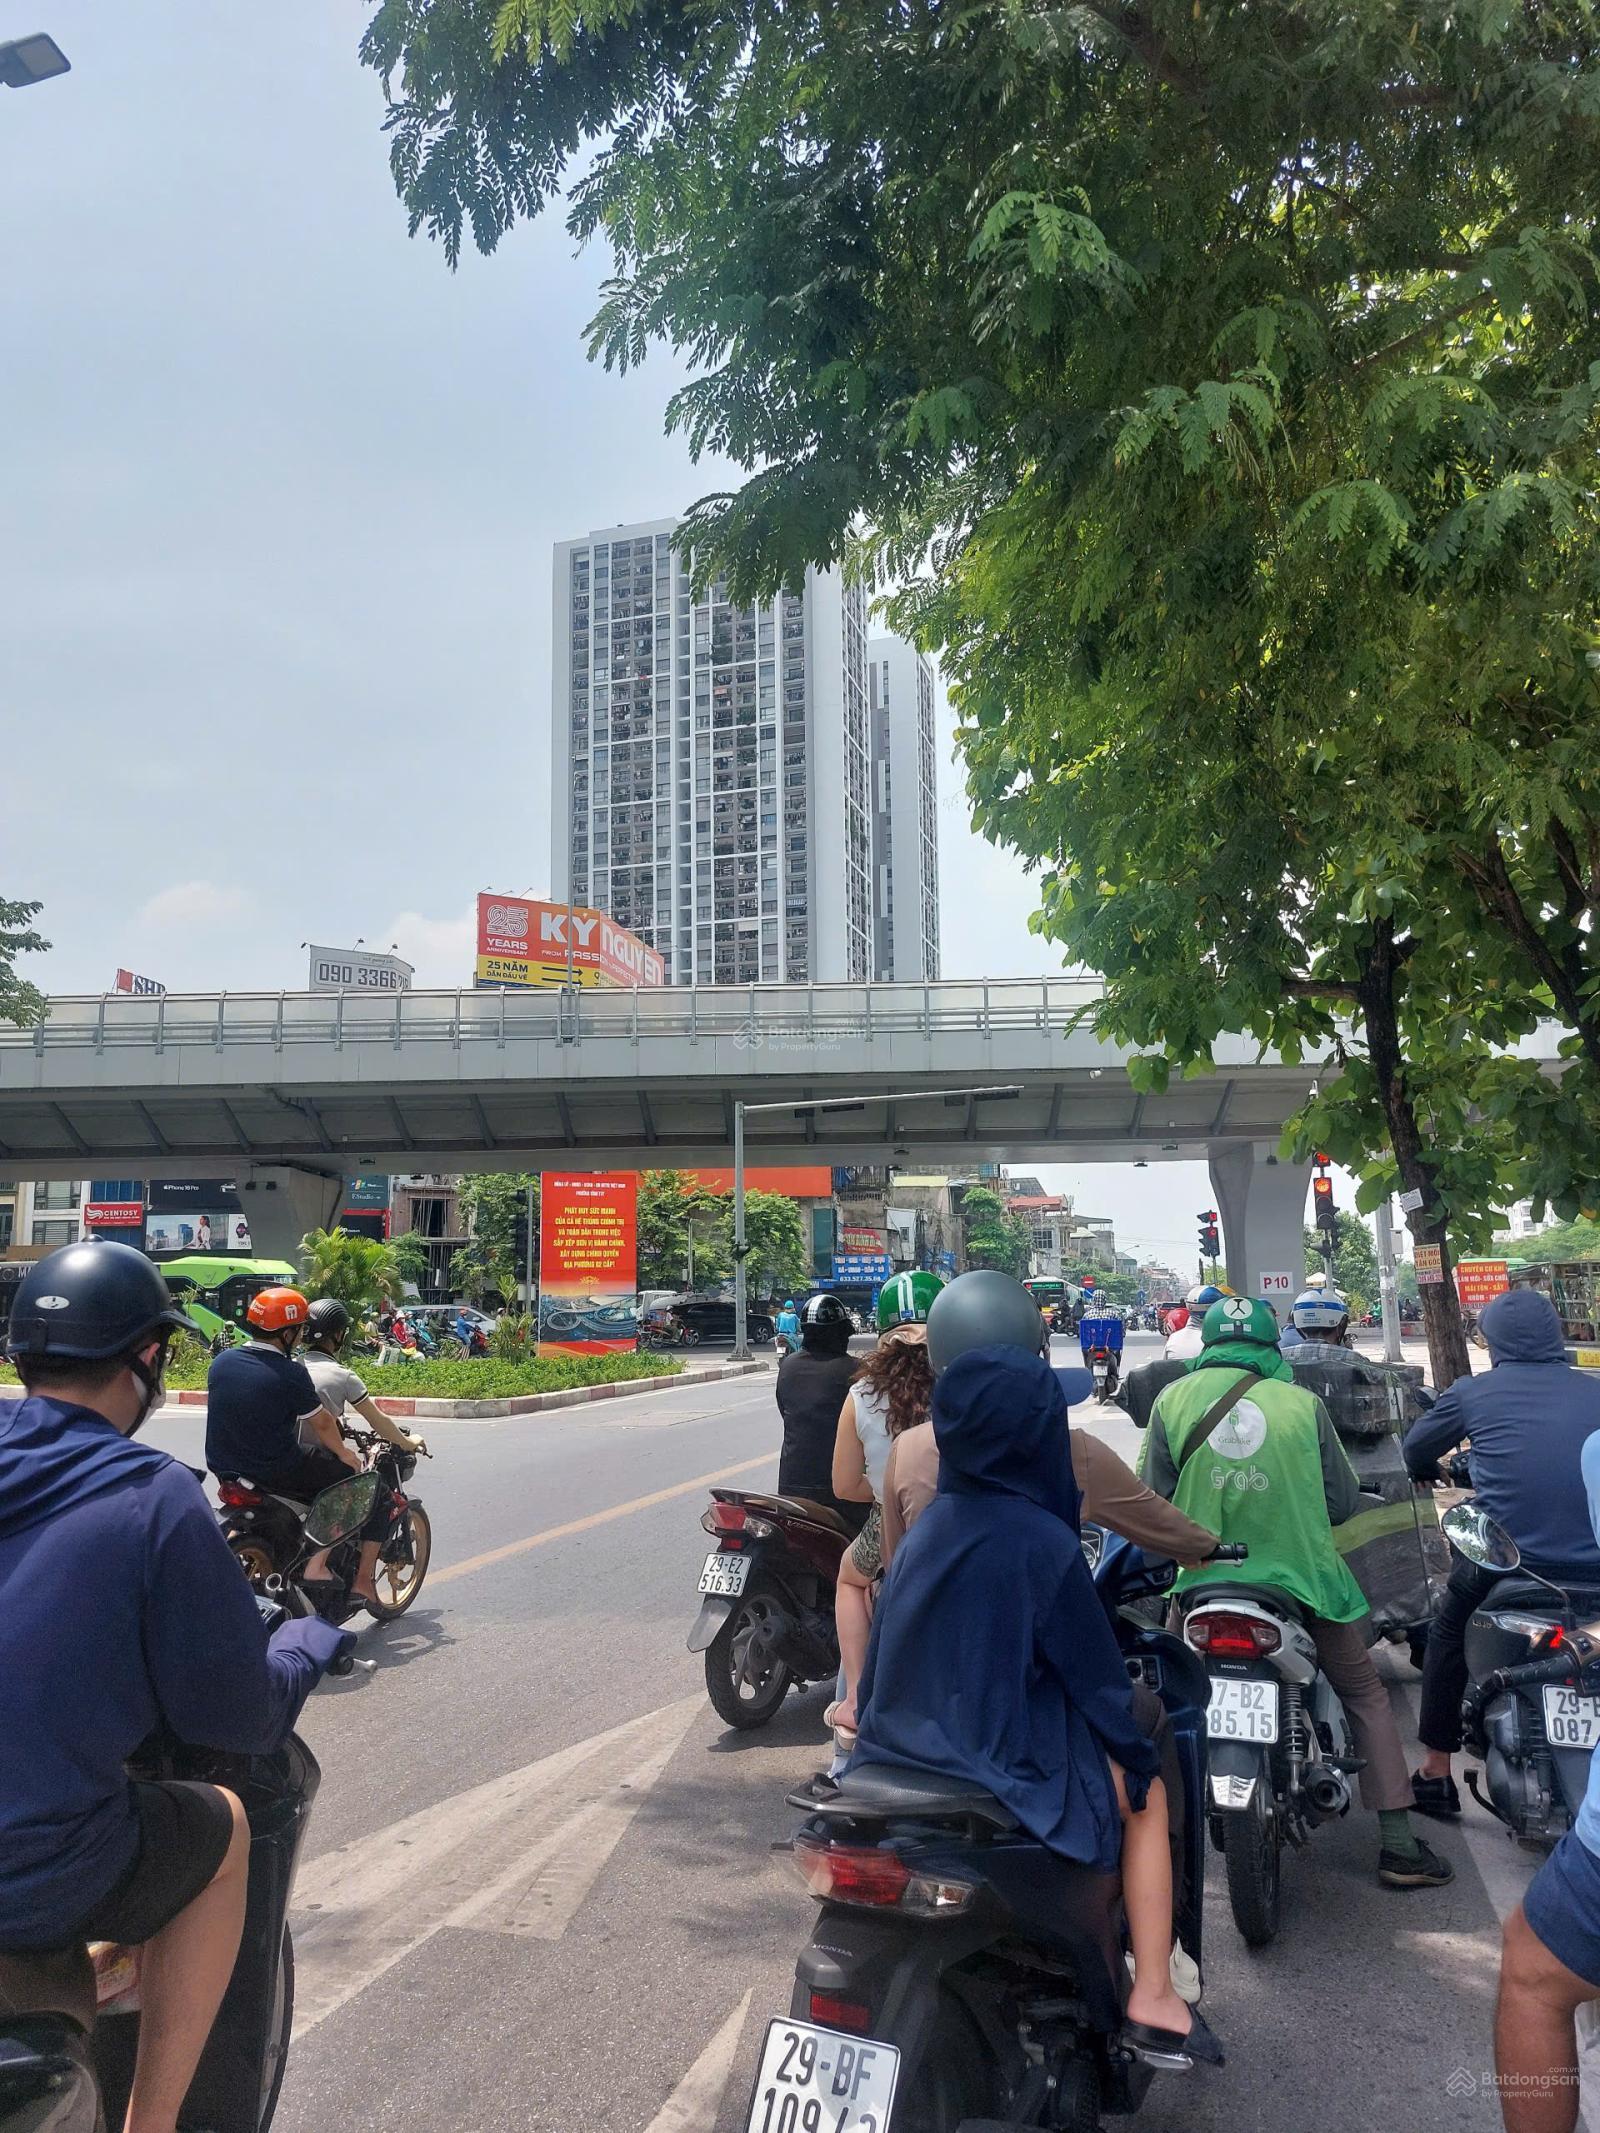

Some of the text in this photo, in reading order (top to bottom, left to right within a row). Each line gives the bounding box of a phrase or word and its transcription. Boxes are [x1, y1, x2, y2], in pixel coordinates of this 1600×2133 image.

[486, 946, 528, 956] ANNIVERSARY
[487, 938, 528, 950] YEARS
[319, 963, 352, 983] 090
[358, 968, 397, 989] 3366
[487, 960, 528, 973] 25 NĂM
[104, 1209, 138, 1217] CENTOSY
[1211, 1465, 1269, 1492] Grab
[709, 1556, 744, 1575] 29-E2
[700, 1573, 742, 1593] 516.33
[1220, 1663, 1248, 1671] HONDA
[1210, 1680, 1265, 1710] 7-B2
[776, 2031, 877, 2100] 29-BF
